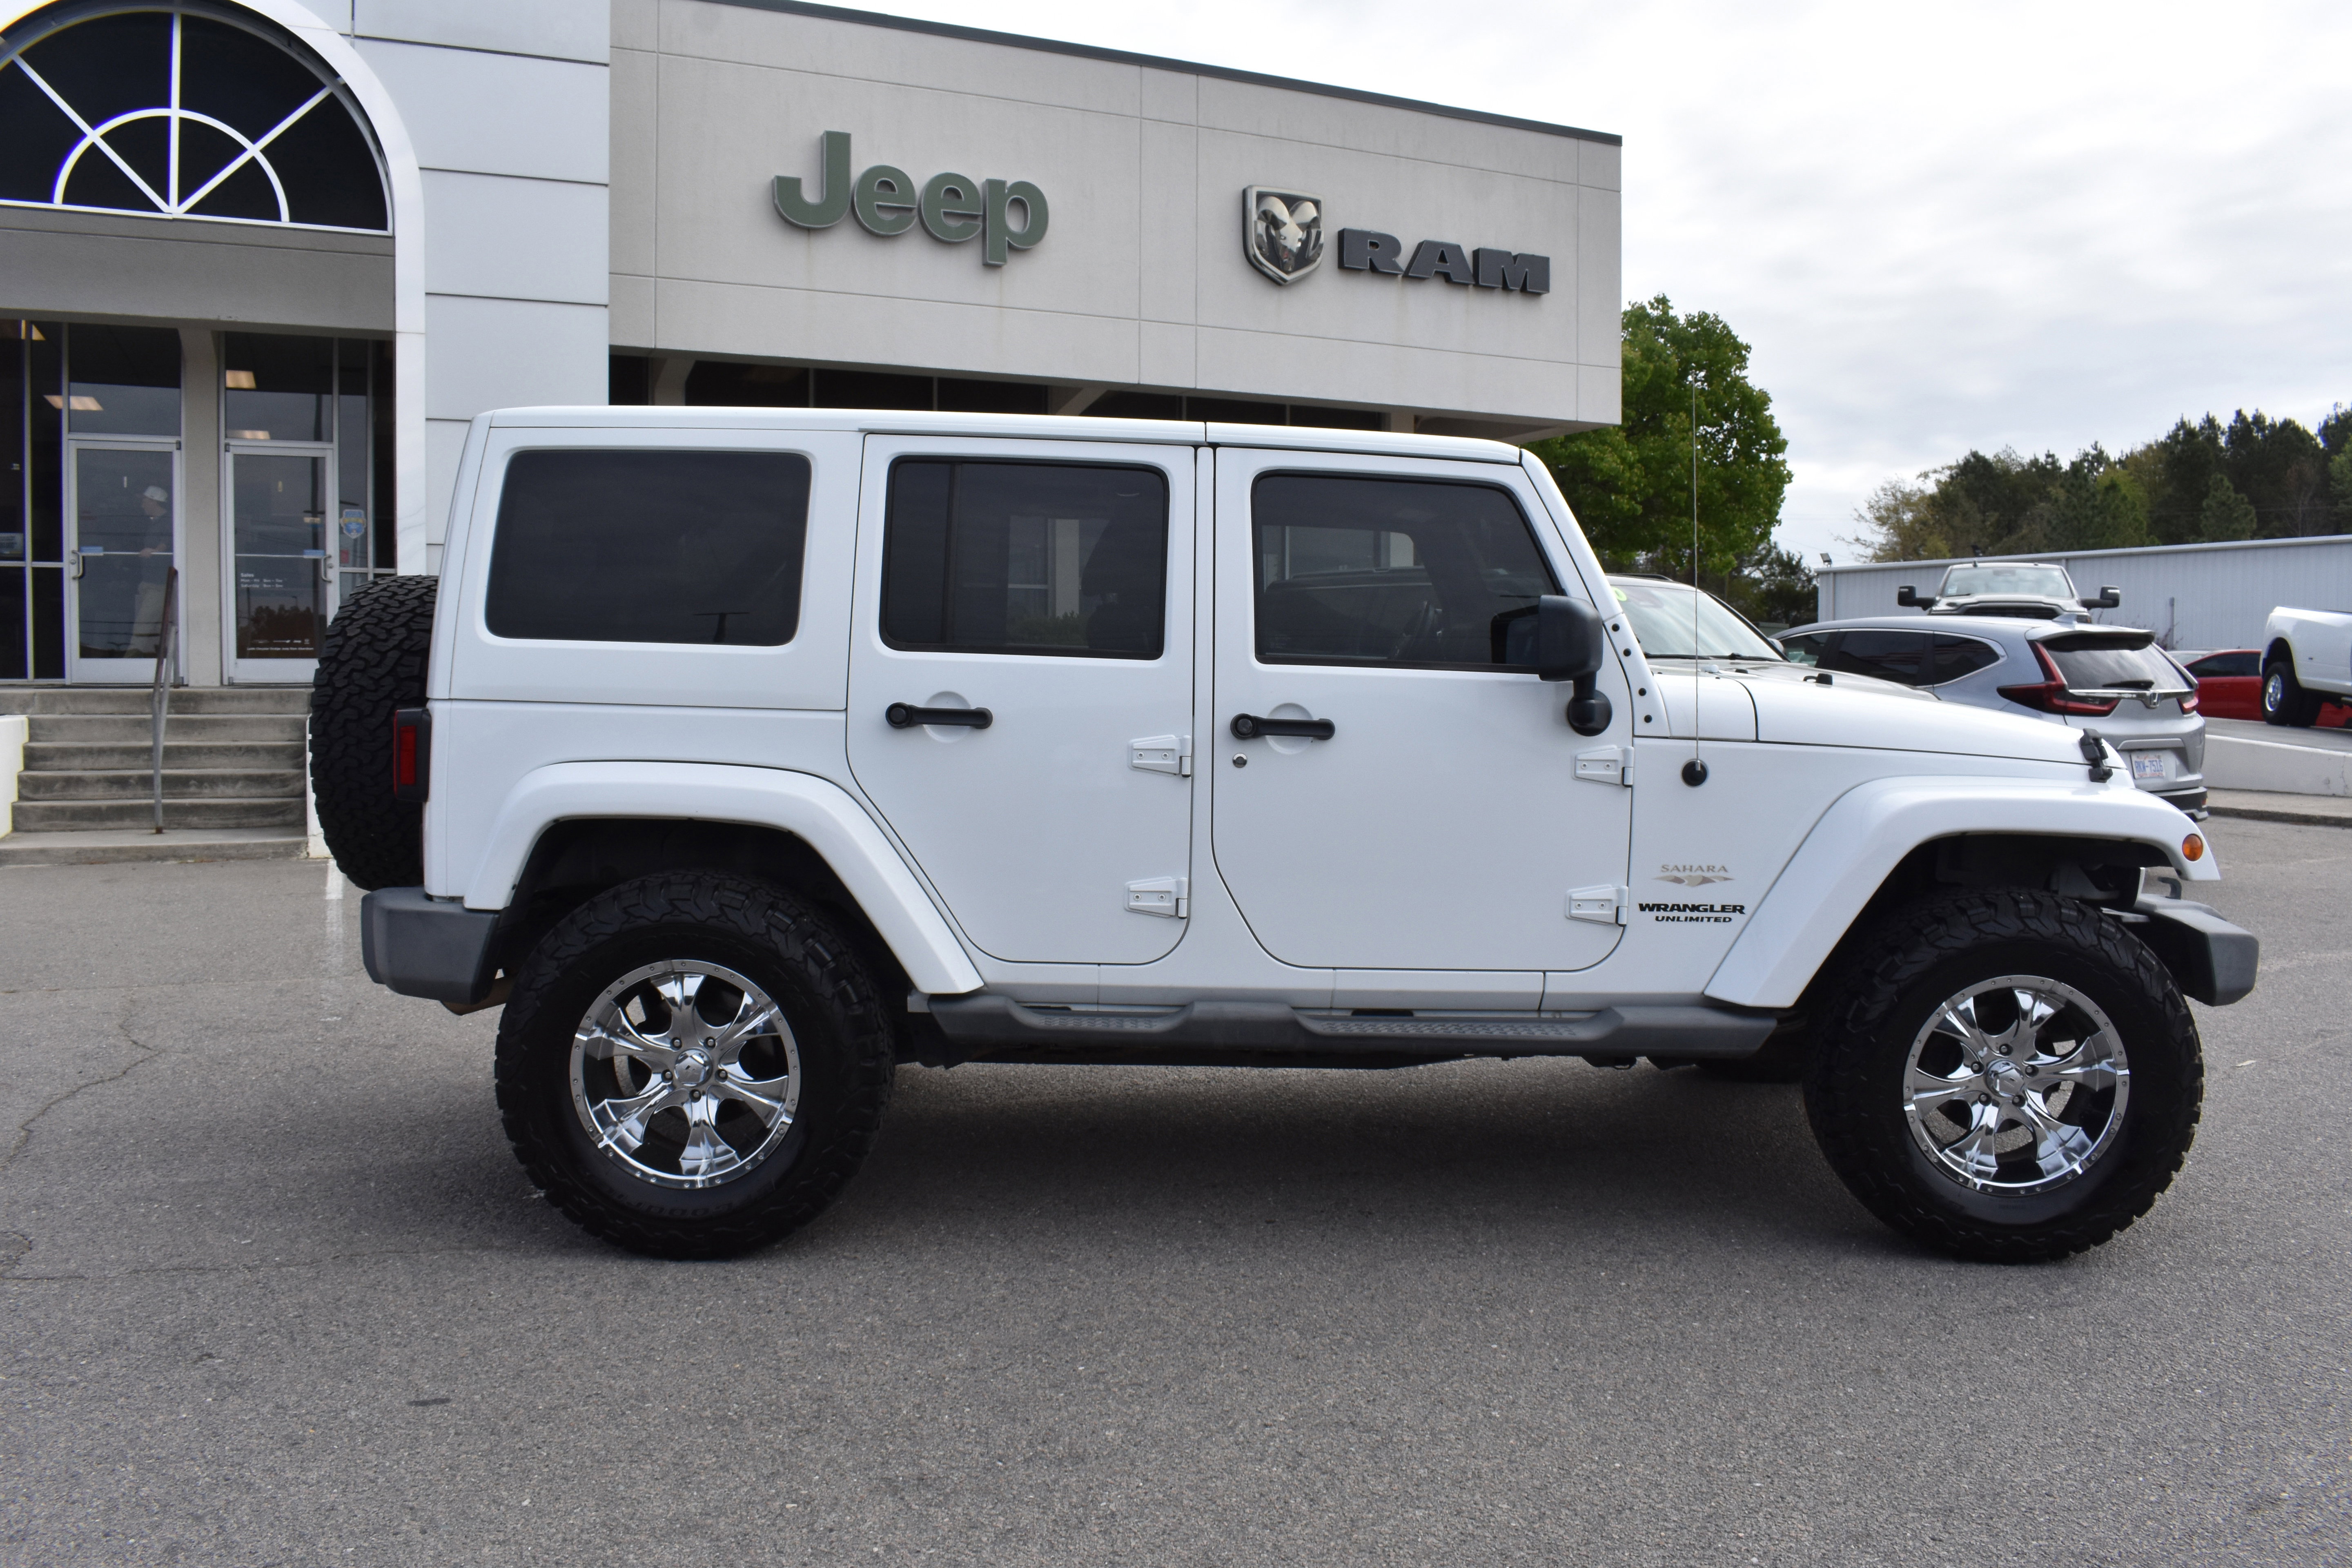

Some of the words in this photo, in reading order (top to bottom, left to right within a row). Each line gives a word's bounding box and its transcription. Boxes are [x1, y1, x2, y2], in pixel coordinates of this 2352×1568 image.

[772, 130, 1049, 267] Jeep
[1338, 228, 1550, 295] RAM
[1638, 903, 1746, 915] WRANGLER
